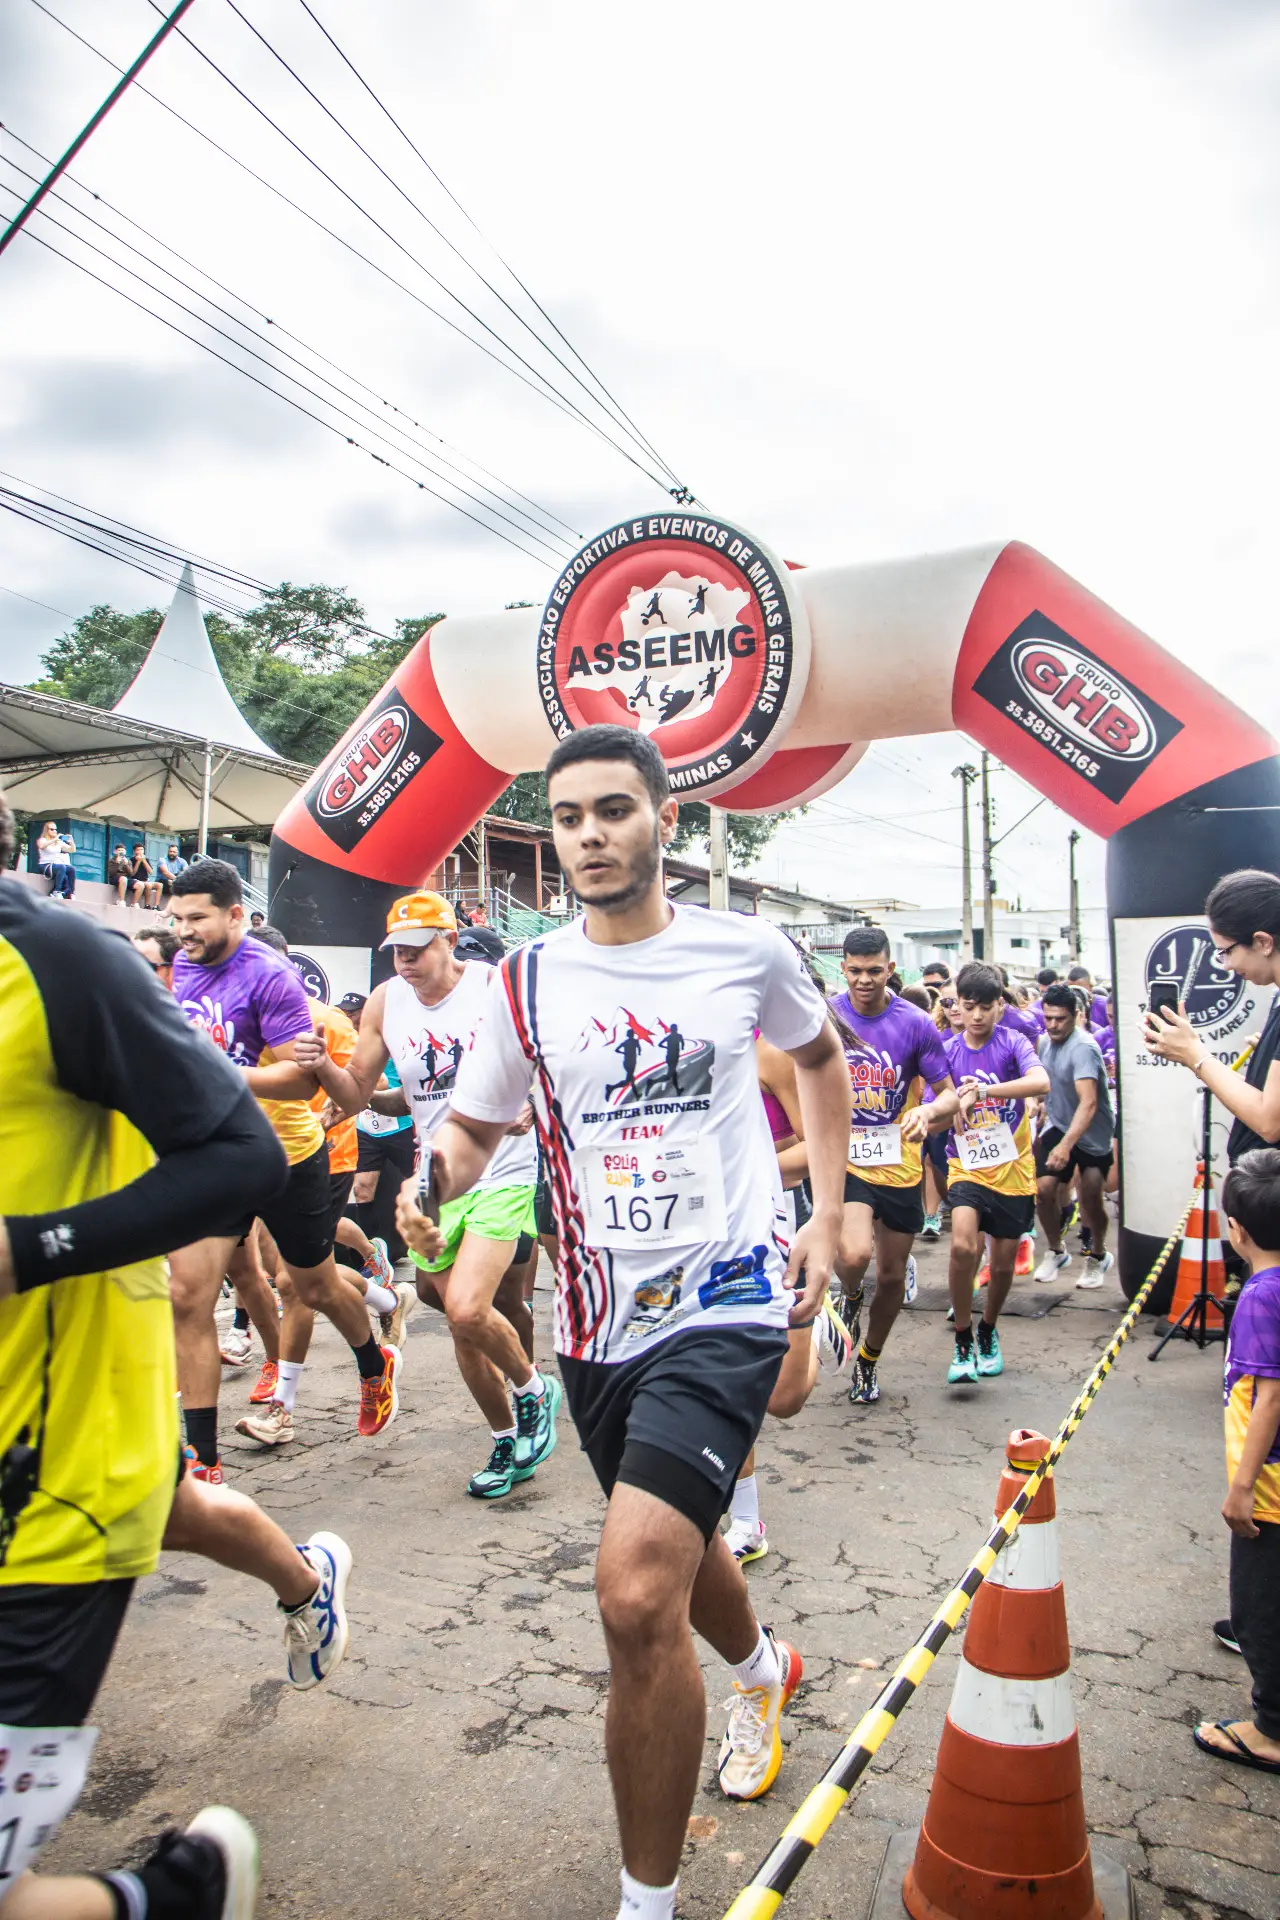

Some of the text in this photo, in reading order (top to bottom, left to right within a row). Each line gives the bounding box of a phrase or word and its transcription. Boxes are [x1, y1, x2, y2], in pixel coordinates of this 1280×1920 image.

[540, 518, 785, 740] ASSOCIAÇÃO ESPORTIVA E EVENTOS DE MINAS GERAIS
[568, 625, 756, 678] ASSEEMG
[1075, 663, 1121, 700] GRUPO
[1022, 651, 1140, 753] GHB
[341, 734, 368, 767] GRUPO
[1005, 700, 1100, 778] 35.3851.2165
[326, 717, 402, 809] GHB
[669, 754, 732, 789] MINAS
[357, 751, 421, 827] 35.3851.2165
[1189, 989, 1236, 1022] FUSOS
[1208, 999, 1256, 1042] VAREJO
[581, 1099, 710, 1124] BROTHER RUNNERS
[620, 1124, 664, 1141] TEAM
[851, 1142, 883, 1159] 154
[968, 1143, 1000, 1164] 248
[604, 1193, 679, 1232] 167
